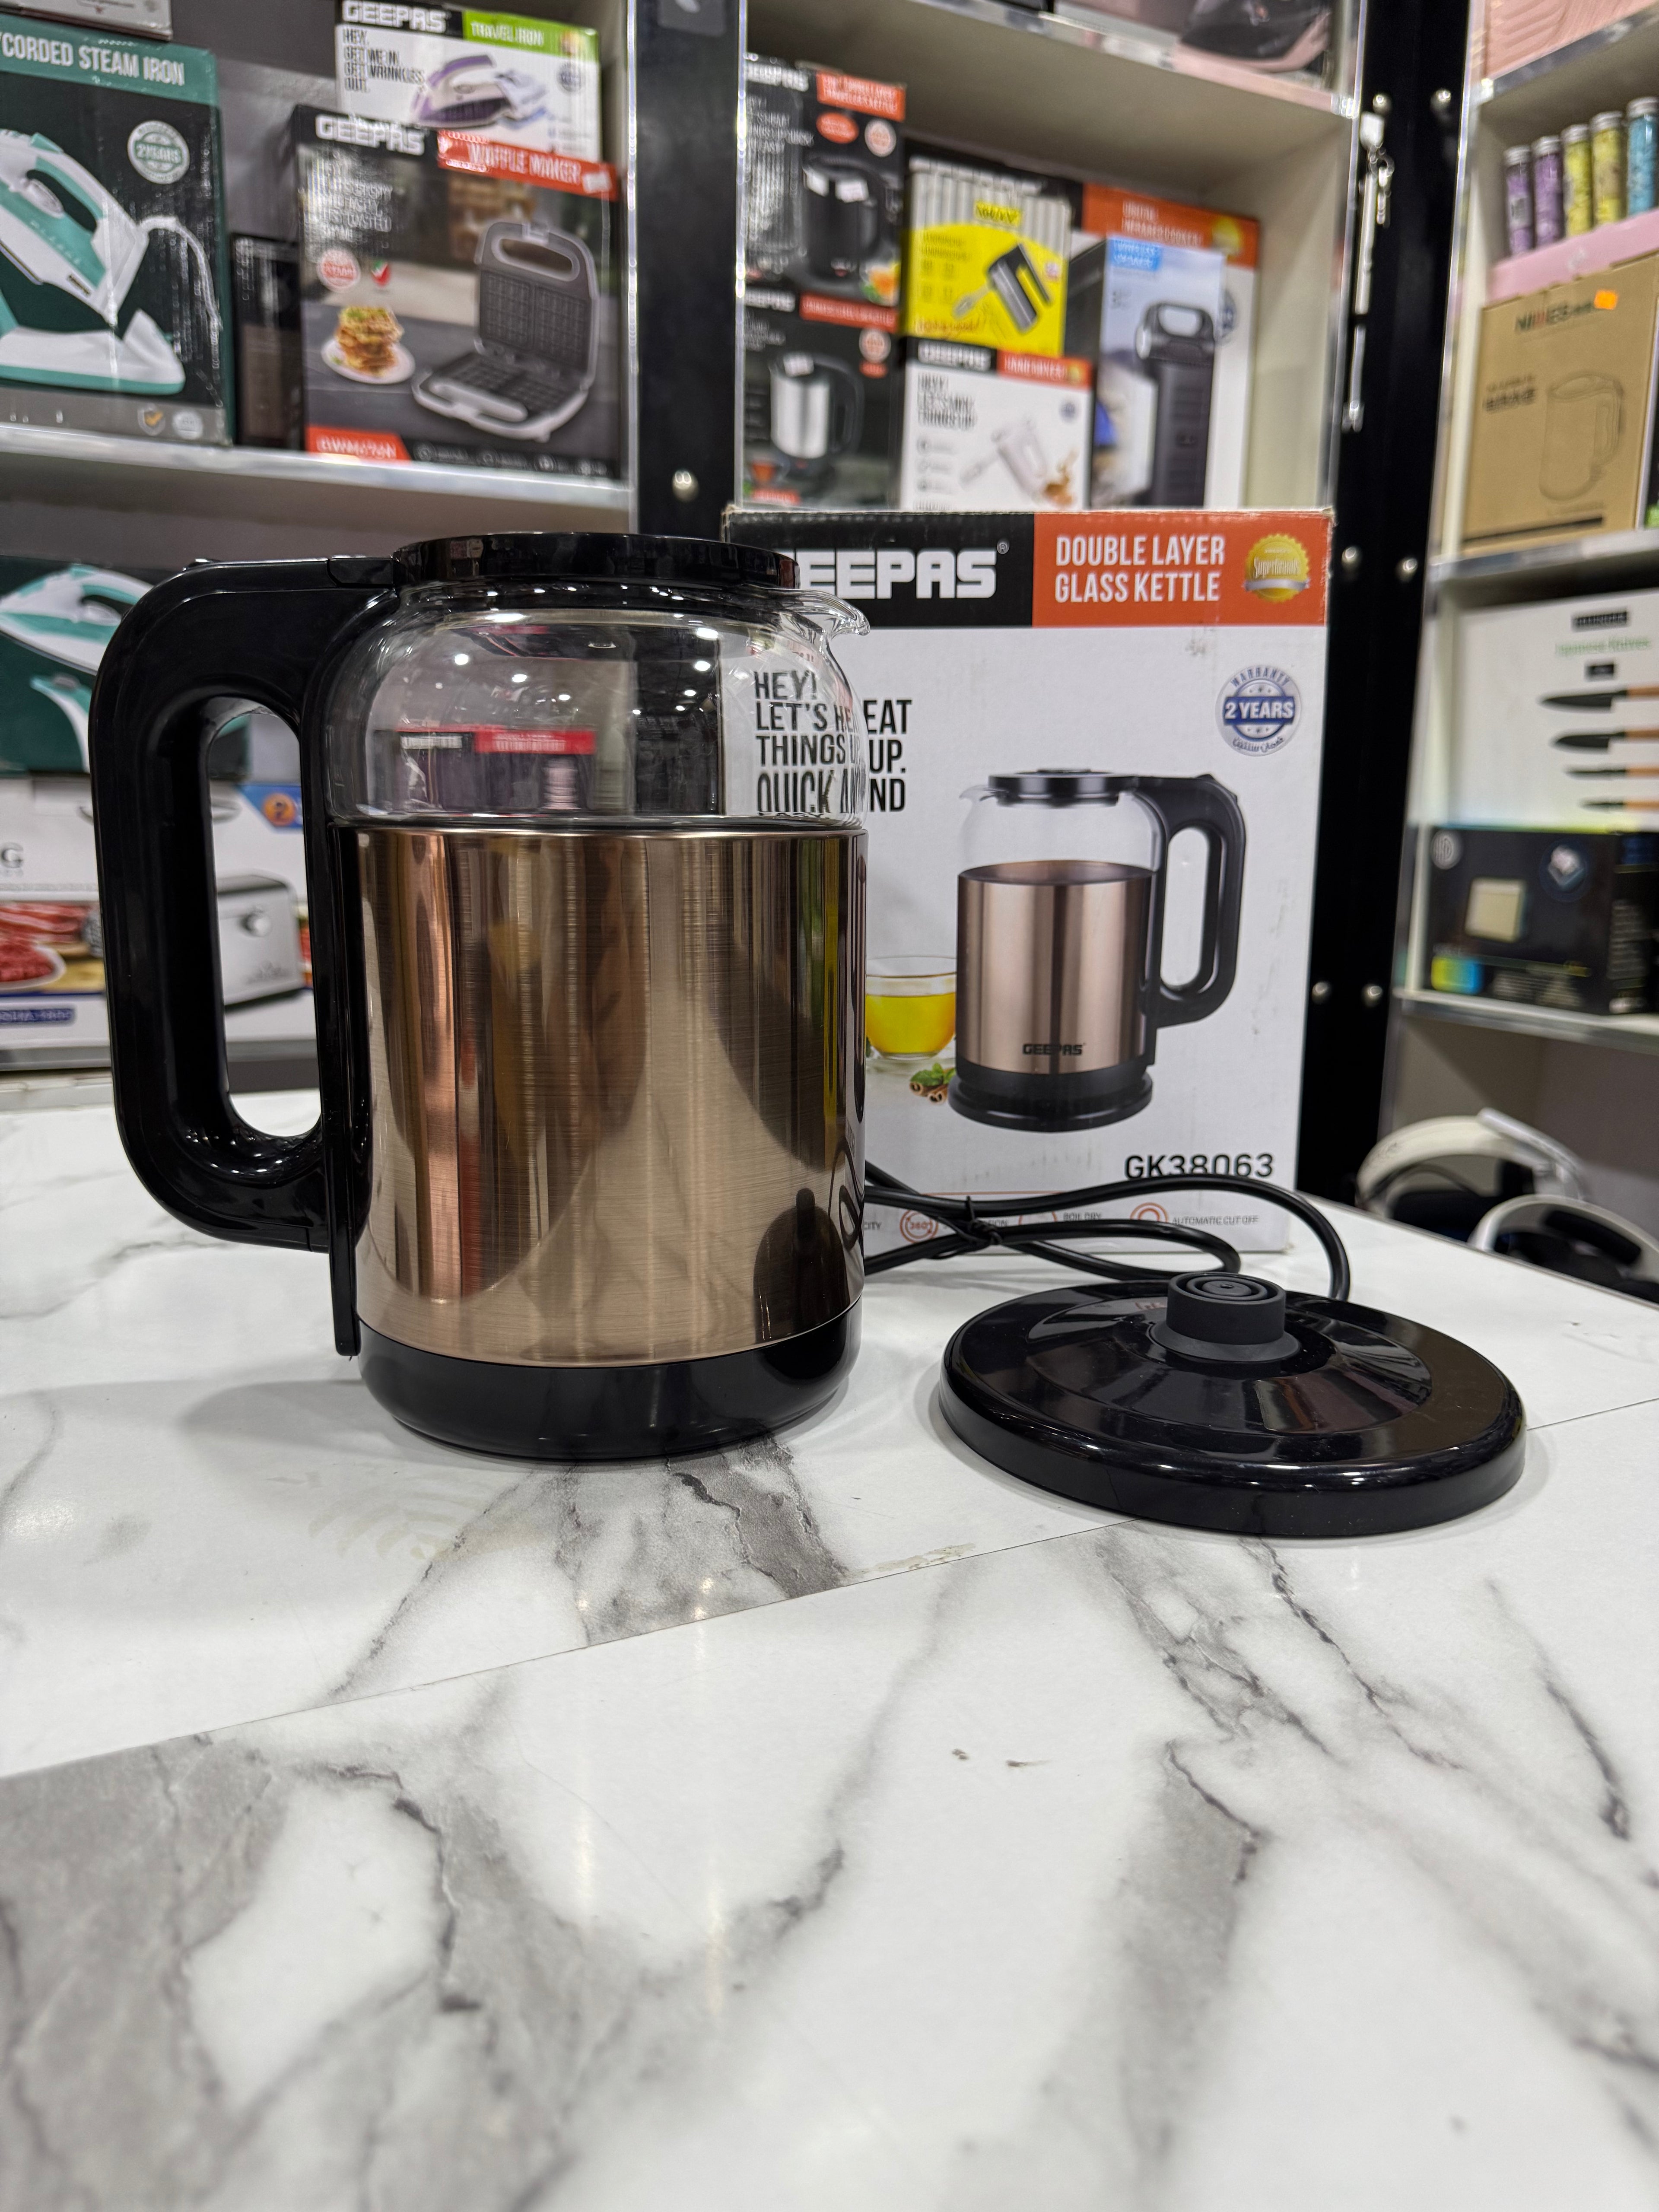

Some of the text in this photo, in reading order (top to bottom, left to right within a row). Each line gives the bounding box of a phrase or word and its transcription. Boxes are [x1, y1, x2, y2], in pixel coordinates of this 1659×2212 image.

[342, 0, 448, 34] GEEPAS
[515, 26, 544, 46] IRON
[78, 45, 139, 78] STEAM
[143, 56, 184, 86] IRON
[315, 114, 425, 156] GEEPAS
[1056, 535, 1225, 566] DOUBLE LAYER
[772, 548, 996, 599] EEPAS
[1055, 571, 1220, 603] GLASS KETTLE
[754, 671, 817, 700] HEY!
[1230, 667, 1290, 687] WARRANTY
[756, 701, 828, 732] LET'S
[1224, 702, 1294, 719] 2 YEARS
[756, 734, 845, 766] THINGS
[757, 769, 834, 814] QUICK
[1125, 1153, 1274, 1180] GK38063
[1172, 1214, 1259, 1226] AUTOMATIC CUT OFF
